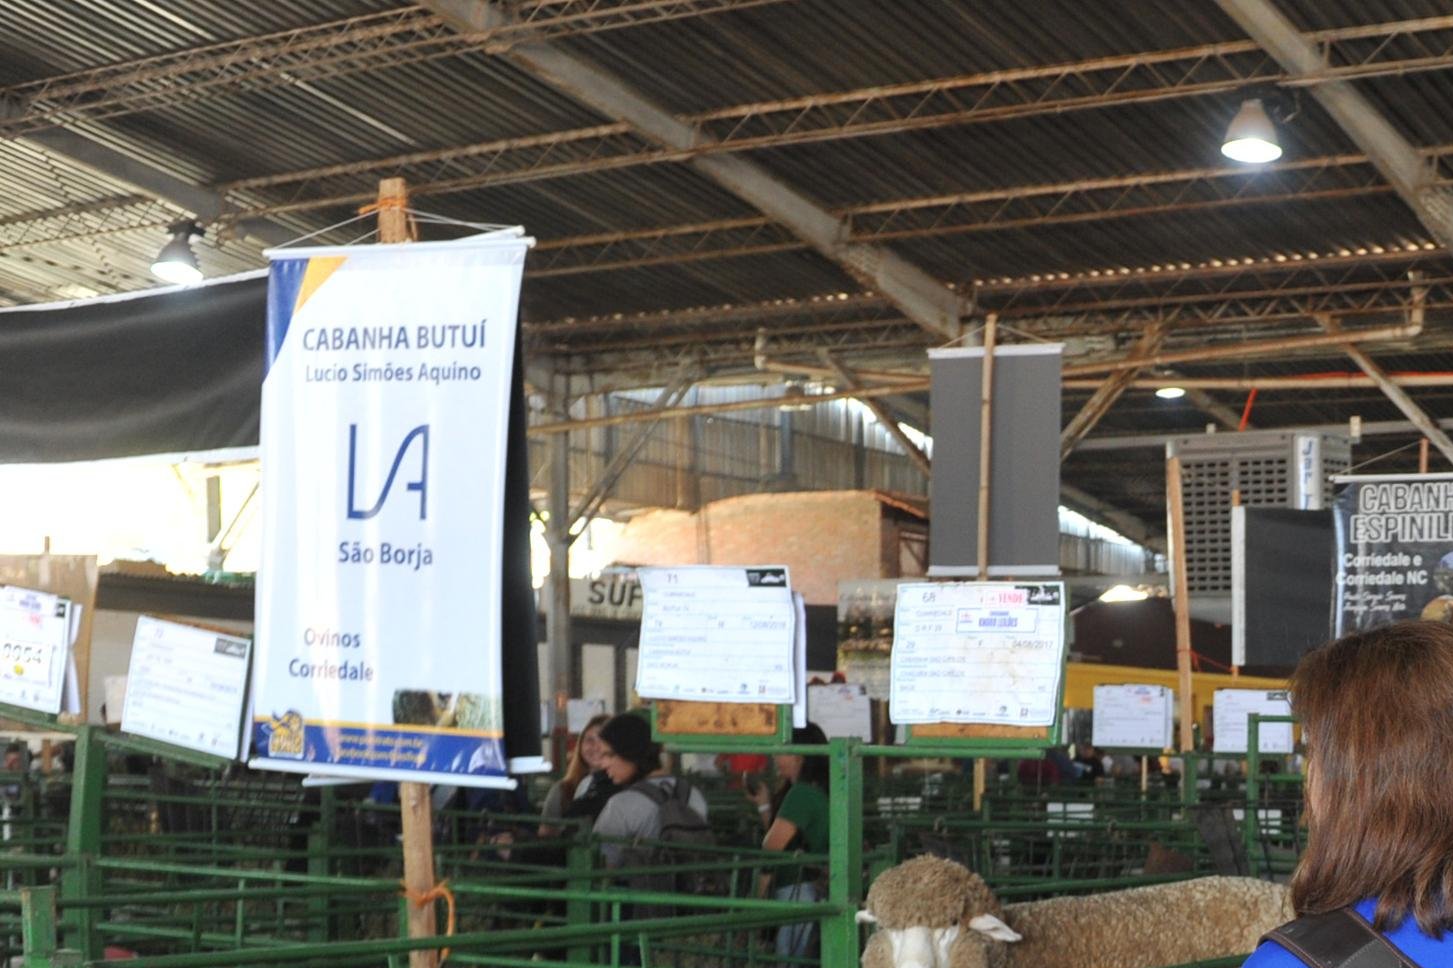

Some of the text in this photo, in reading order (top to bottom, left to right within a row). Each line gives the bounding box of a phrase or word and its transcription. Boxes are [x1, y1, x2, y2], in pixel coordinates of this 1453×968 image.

[303, 319, 488, 350] CABANHA BUTUÍ
[305, 361, 482, 385] Lucio Simões Aquino
[338, 541, 433, 570] São Borja
[1344, 552, 1423, 567] Corriedale e
[1336, 570, 1429, 586] Corriedale NC
[304, 627, 361, 649] Ovinos
[288, 658, 374, 683] Corriedale
